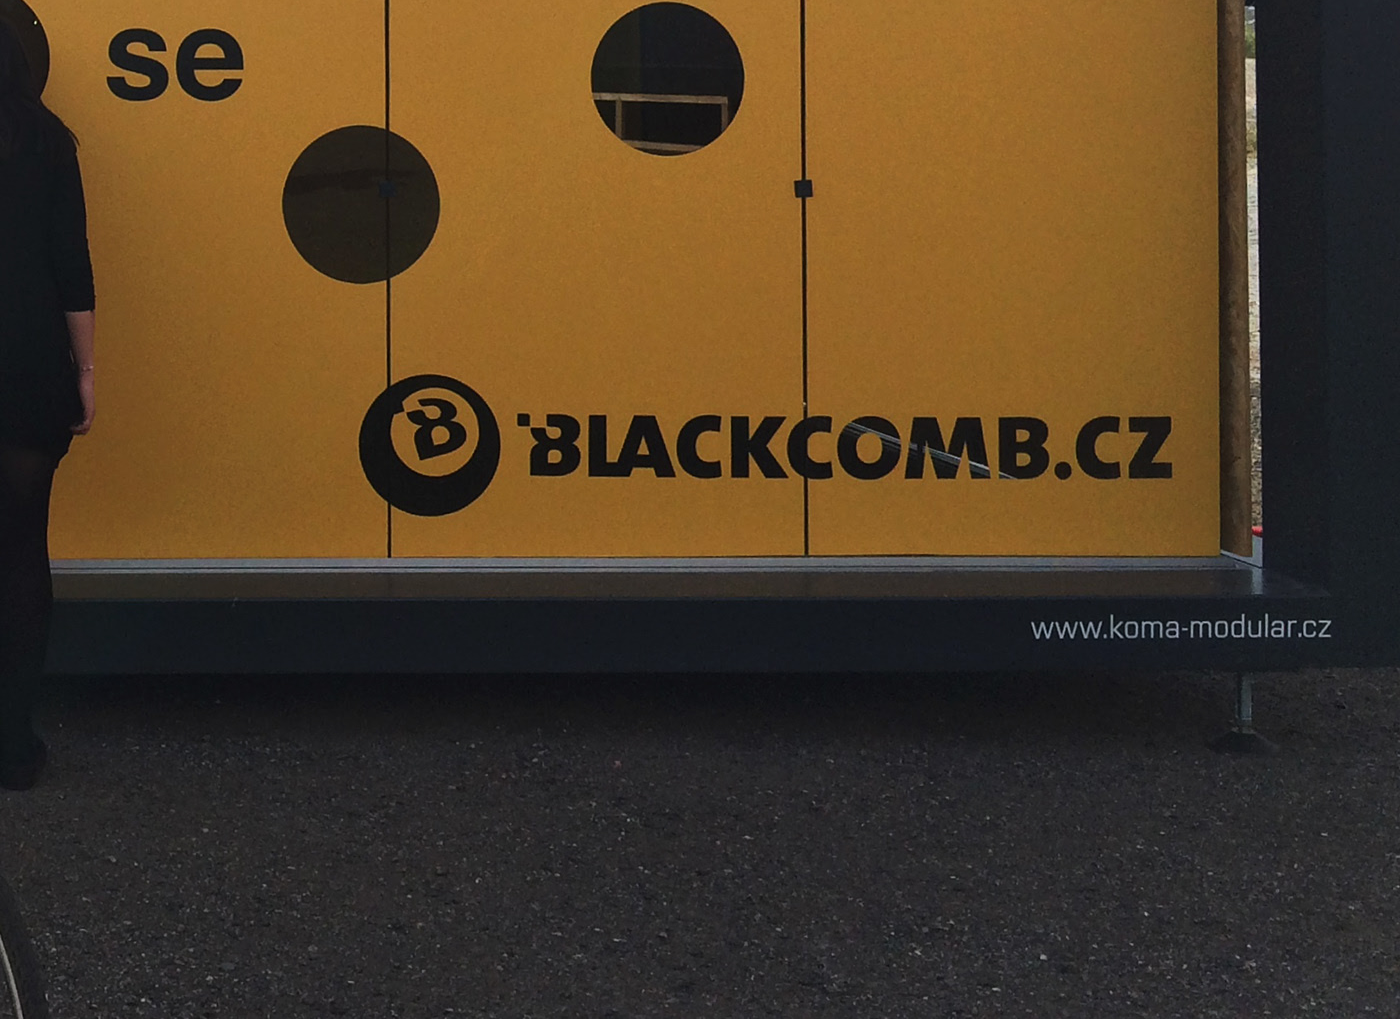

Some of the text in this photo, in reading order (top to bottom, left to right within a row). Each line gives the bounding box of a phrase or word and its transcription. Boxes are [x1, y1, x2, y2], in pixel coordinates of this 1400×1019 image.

[107, 28, 245, 102] se
[516, 412, 1173, 481] BLACKCOMB.CZ
[1030, 613, 1332, 640] www.koma-modular.cz
